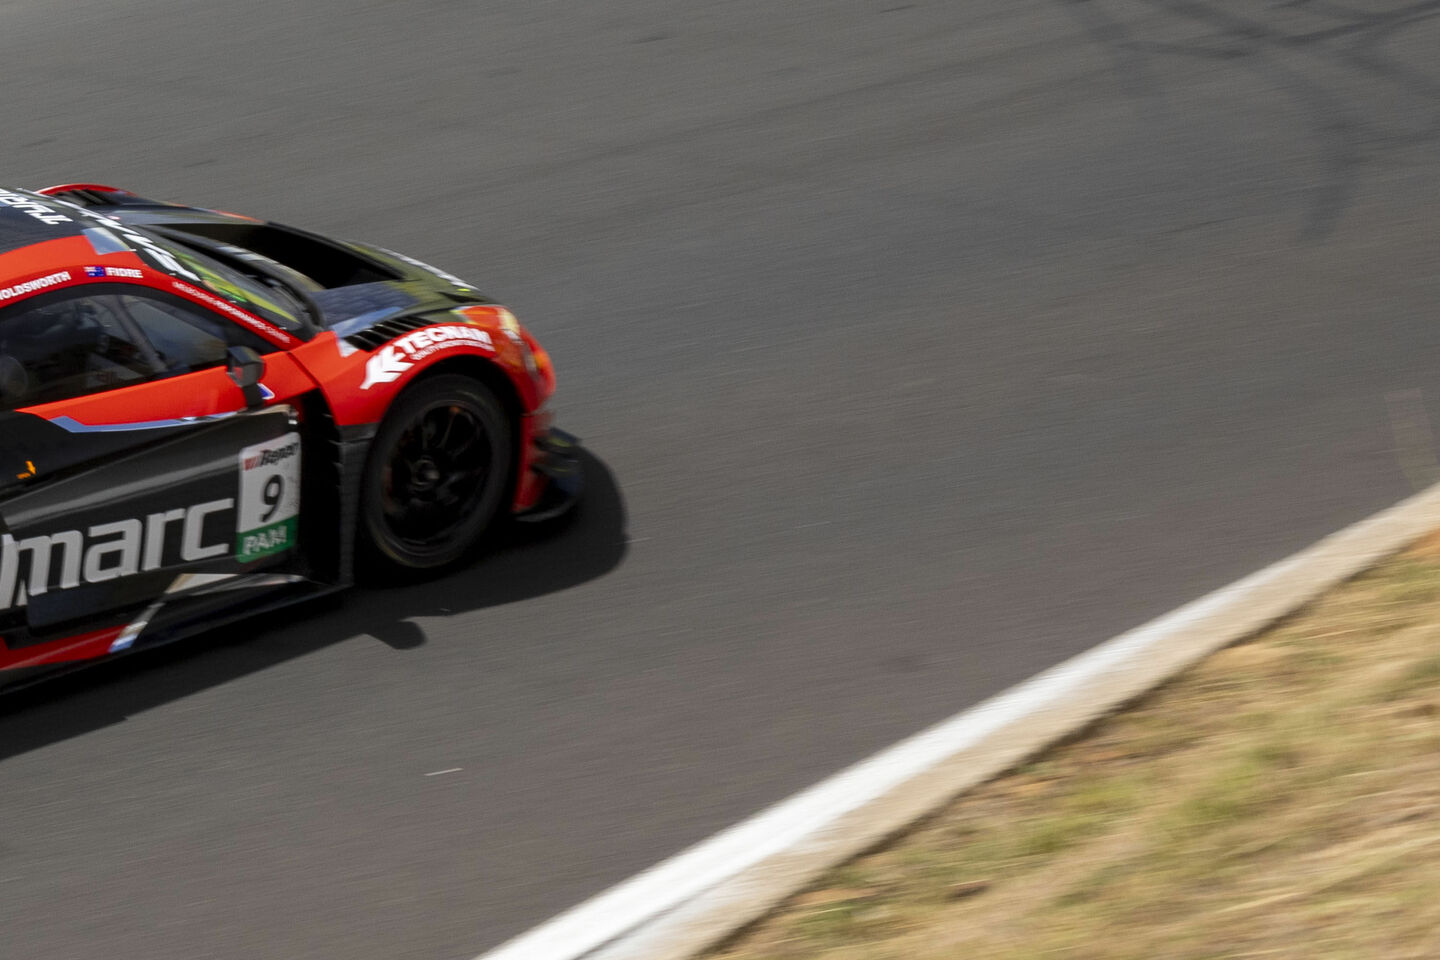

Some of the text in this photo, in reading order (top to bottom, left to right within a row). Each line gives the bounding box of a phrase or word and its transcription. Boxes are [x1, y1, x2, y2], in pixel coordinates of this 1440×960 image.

[105, 267, 144, 279] FIORE
[393, 325, 493, 354] TECNAM
[260, 474, 284, 523] 9
[243, 525, 287, 555] PAM
